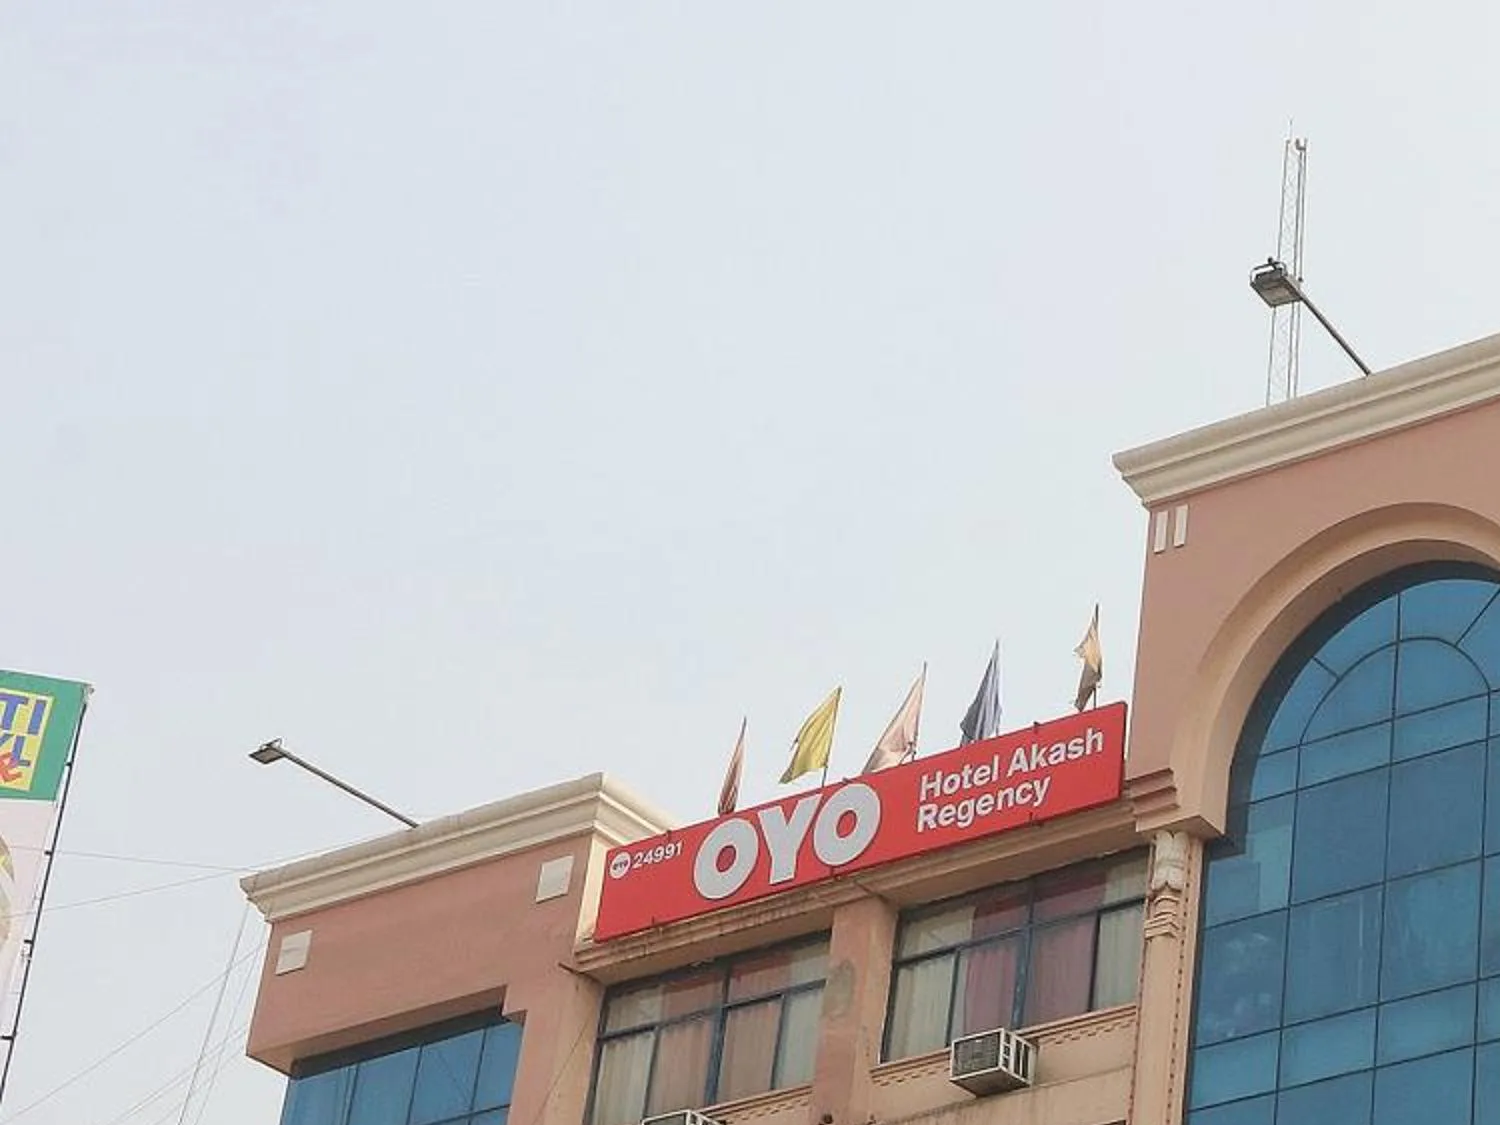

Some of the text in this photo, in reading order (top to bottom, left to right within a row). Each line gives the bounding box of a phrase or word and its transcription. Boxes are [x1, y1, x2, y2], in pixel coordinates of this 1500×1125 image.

[920, 727, 1103, 801] Hotel Akash
[917, 775, 1051, 833] Regency
[632, 840, 684, 869] 24991
[694, 783, 881, 899] OYO
